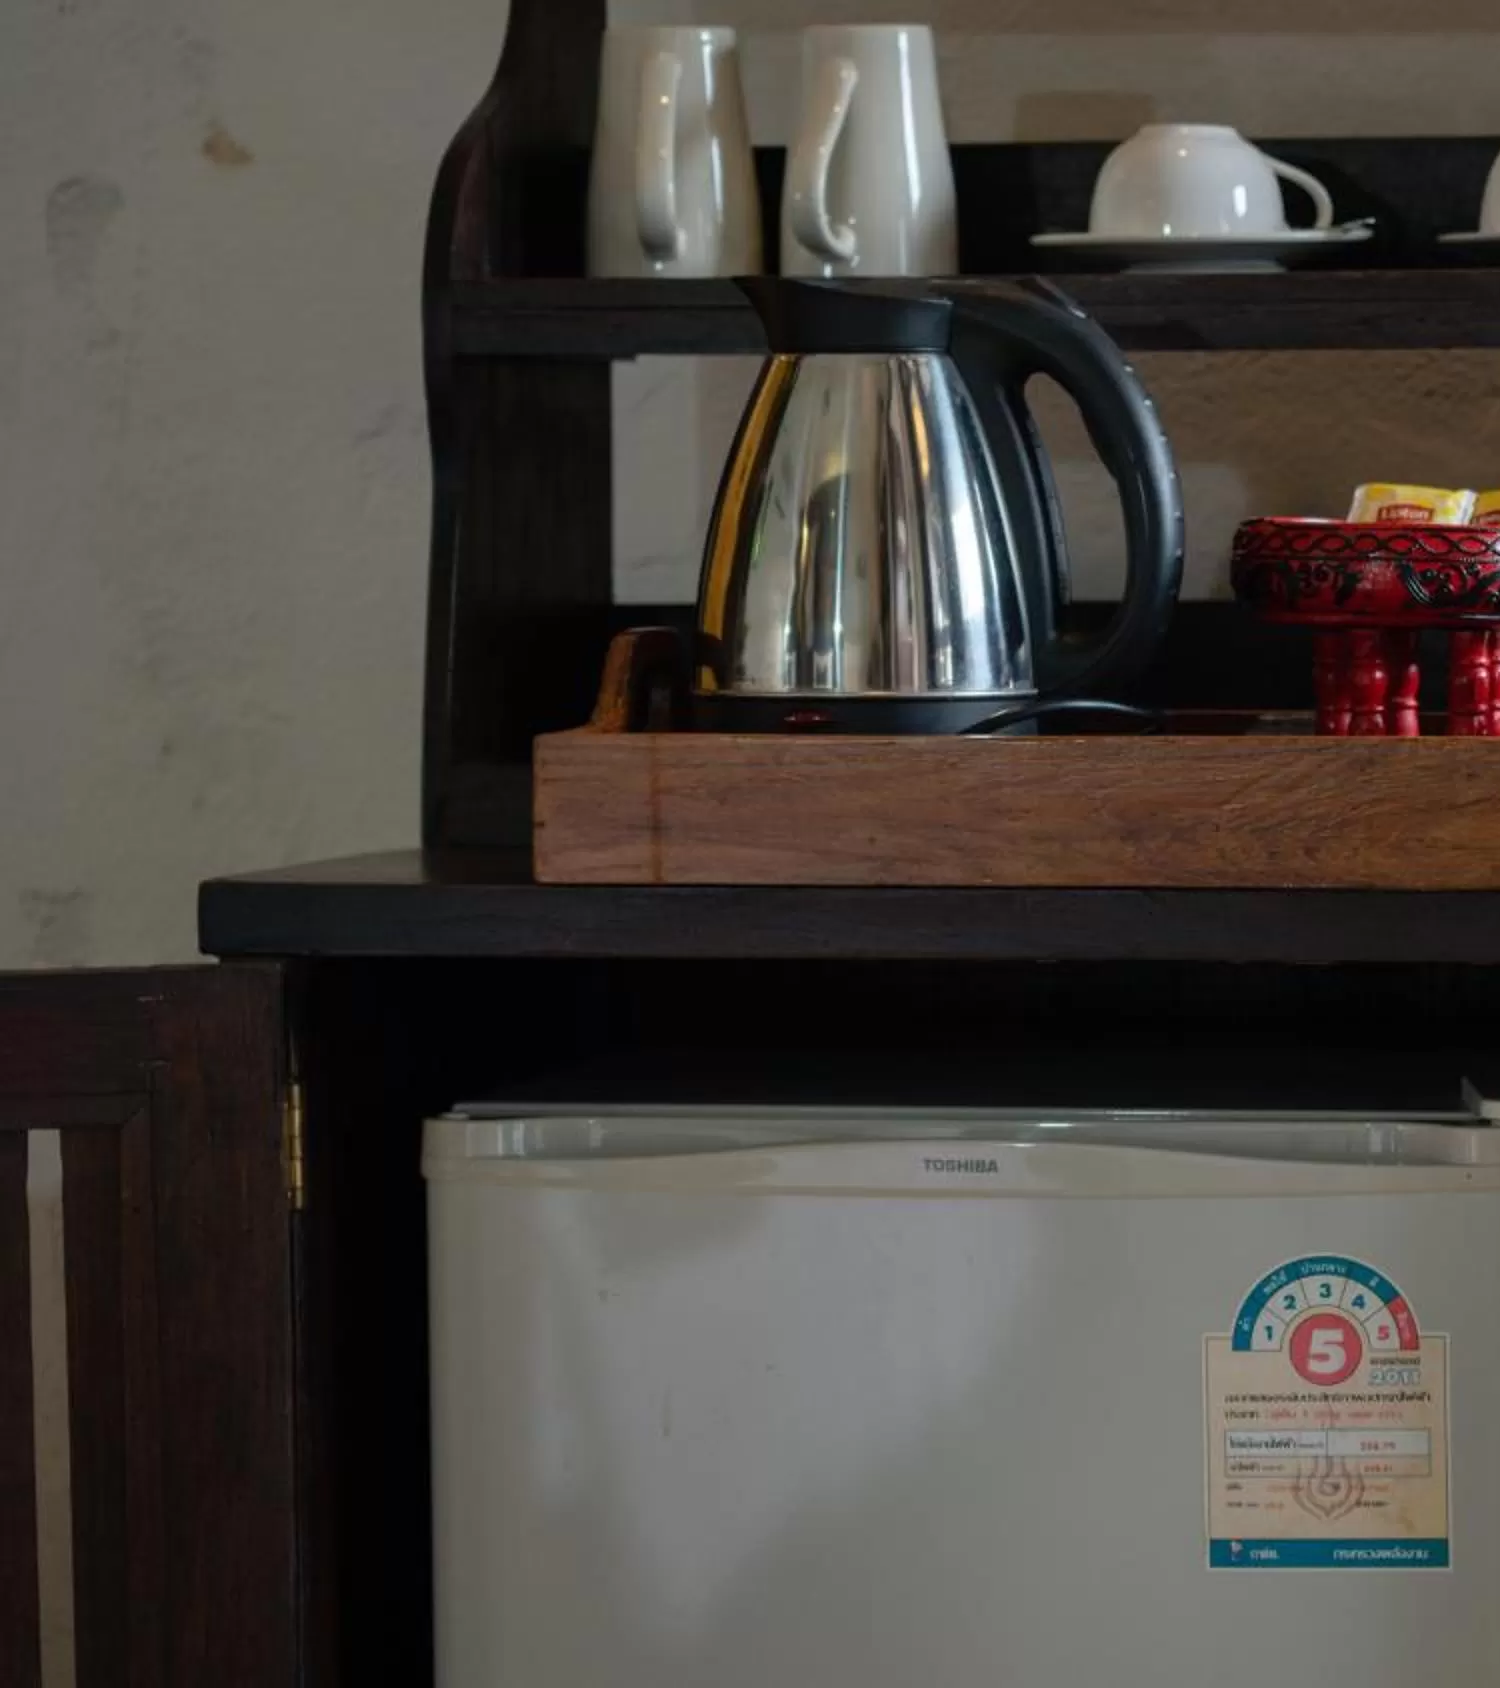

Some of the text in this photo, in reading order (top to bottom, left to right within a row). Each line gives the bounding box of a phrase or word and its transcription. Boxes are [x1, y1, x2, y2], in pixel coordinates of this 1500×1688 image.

[923, 1158, 999, 1174] TOSHIBA
[1264, 1325, 1274, 1341] 1
[1283, 1294, 1297, 1310] 2
[1318, 1283, 1332, 1299] 3
[1351, 1294, 1366, 1309] 4
[1376, 1325, 1390, 1341] 5
[1307, 1328, 1346, 1375] 5
